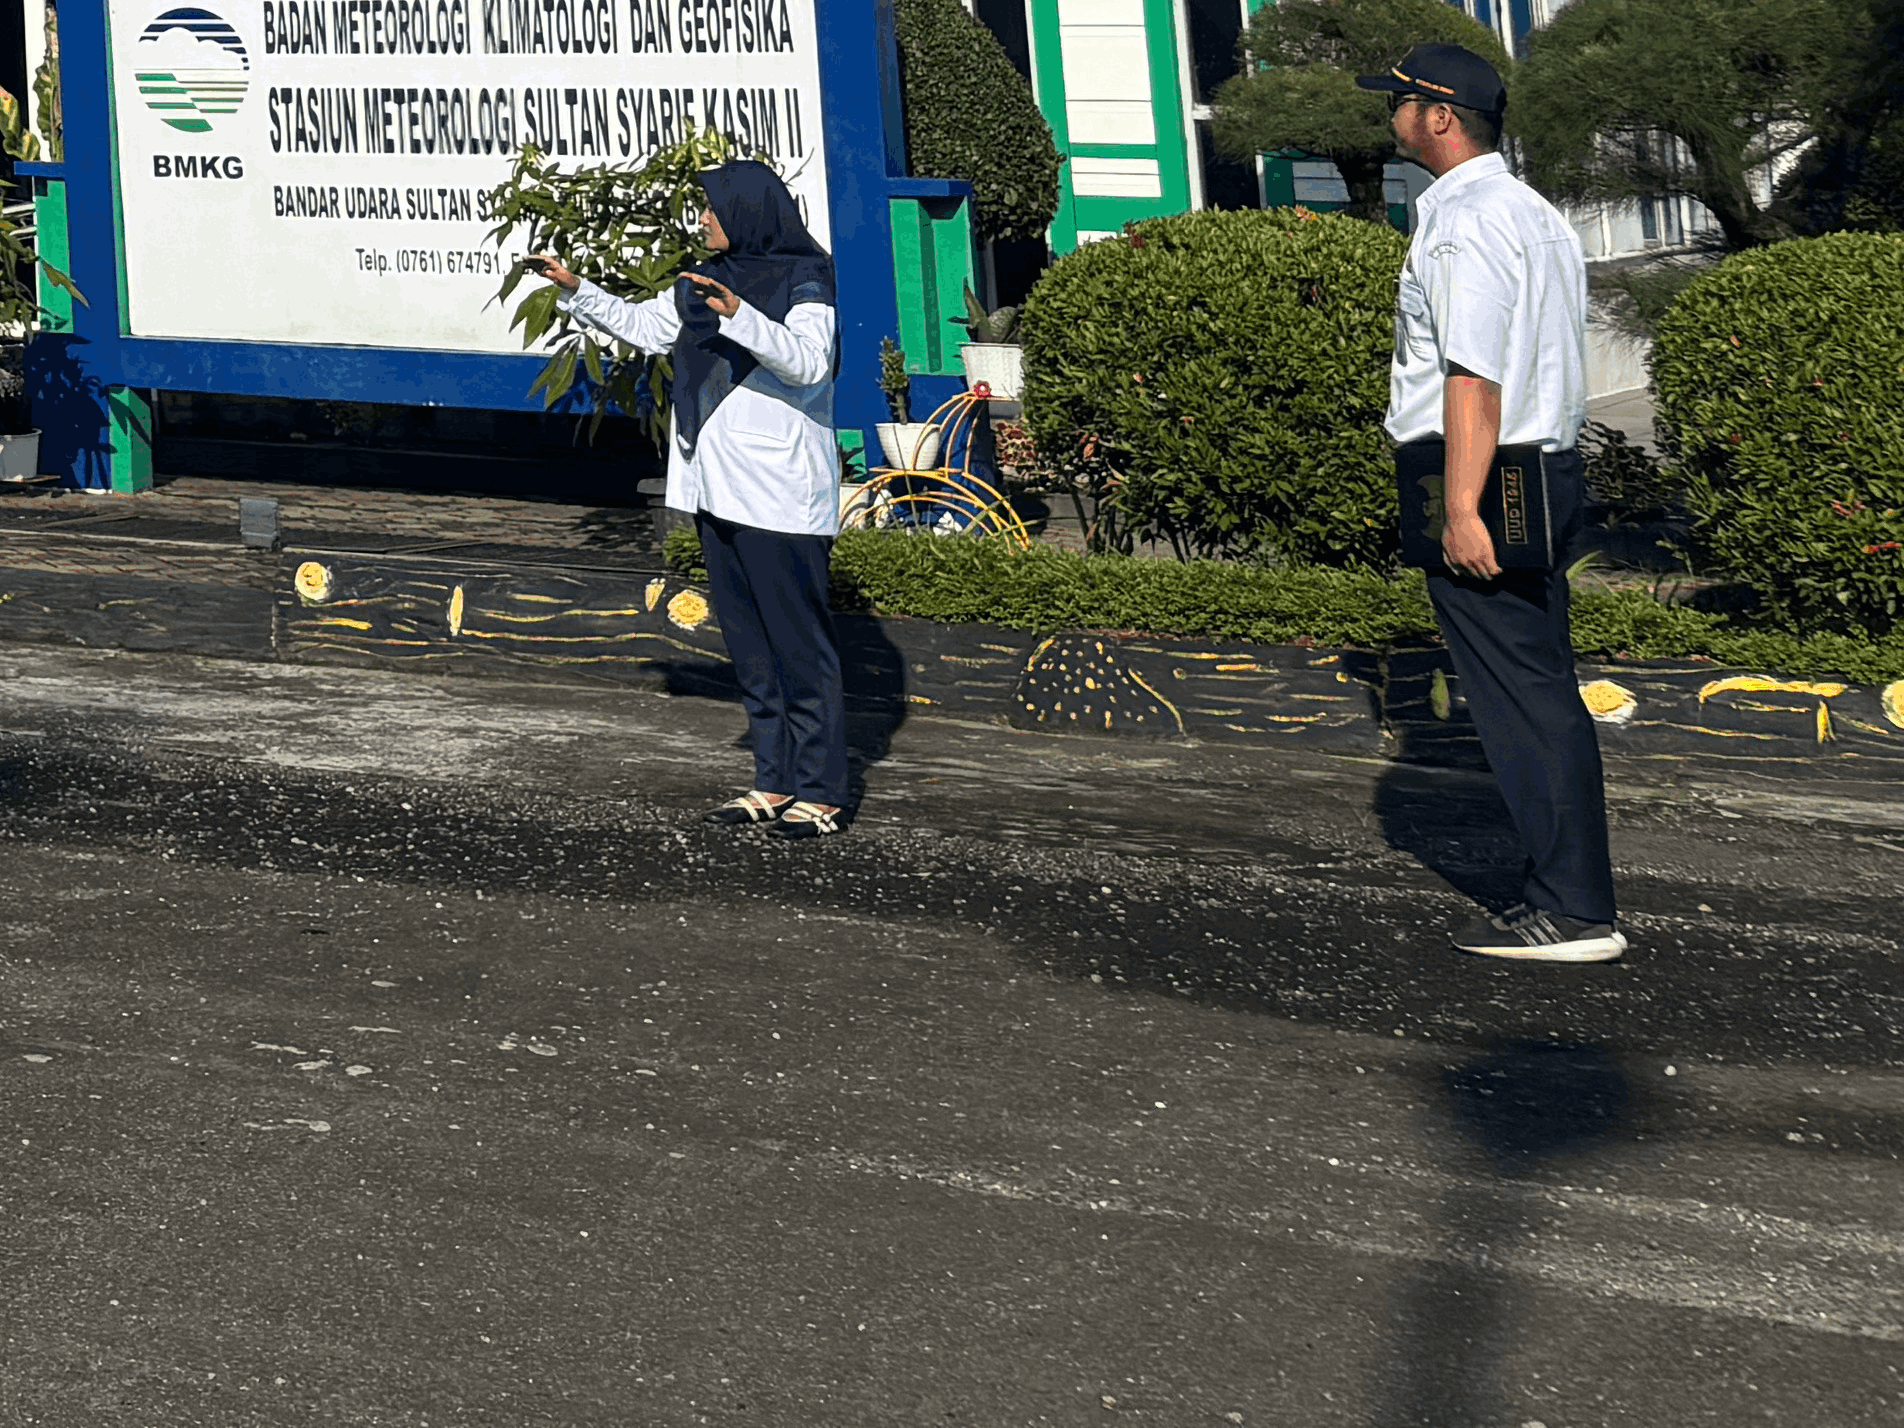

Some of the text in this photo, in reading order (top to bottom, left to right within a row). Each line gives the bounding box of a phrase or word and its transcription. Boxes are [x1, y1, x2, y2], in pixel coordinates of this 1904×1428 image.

[263, 0, 327, 54] BADAN
[268, 86, 359, 154] STASIUN
[363, 86, 517, 155] METEOROLOGI
[524, 86, 611, 157] SULTAN
[785, 87, 804, 159] II
[152, 154, 244, 180] BMKG
[273, 185, 341, 219] BANDAR
[345, 186, 402, 221] UDARA
[407, 187, 472, 222] SULTAN
[355, 248, 392, 277] Telp.
[396, 249, 443, 275] (0761)
[1508, 508, 1522, 539] UUD
